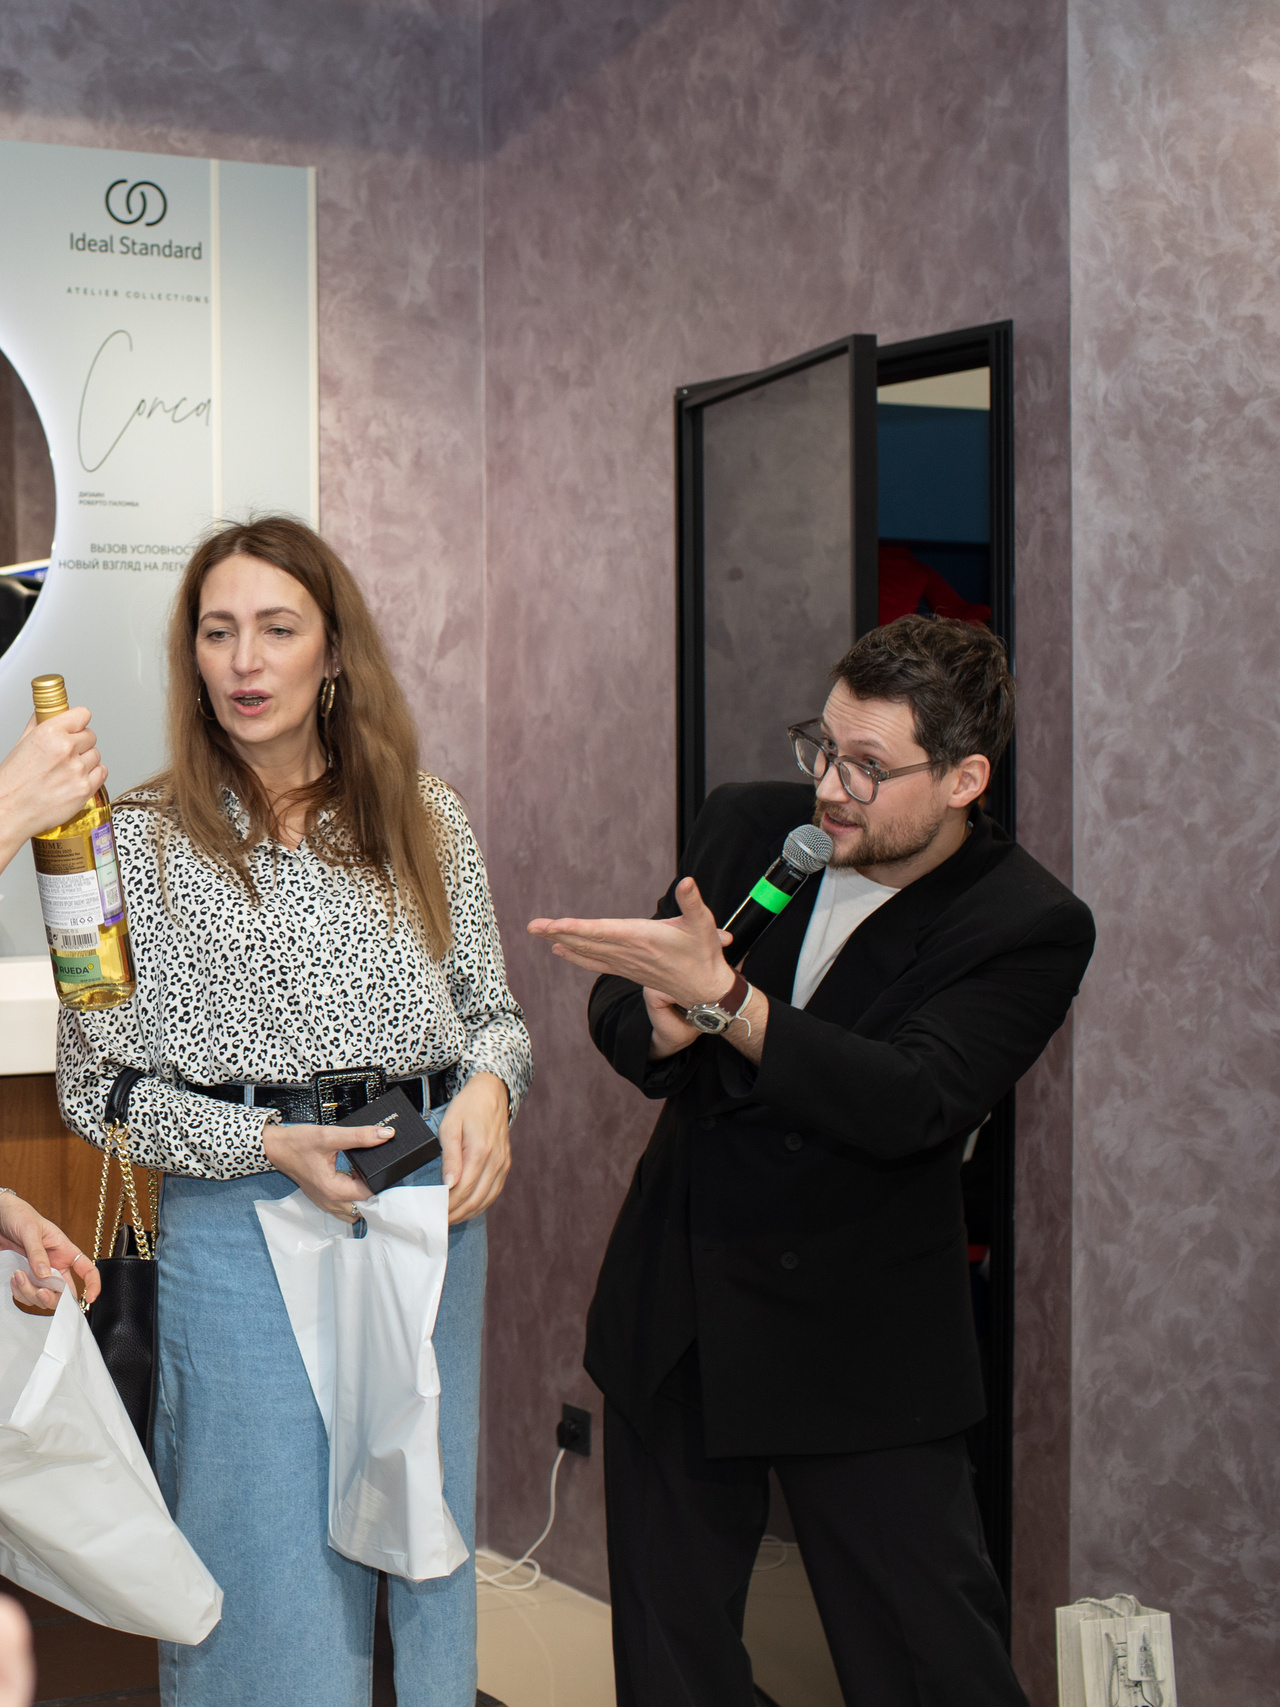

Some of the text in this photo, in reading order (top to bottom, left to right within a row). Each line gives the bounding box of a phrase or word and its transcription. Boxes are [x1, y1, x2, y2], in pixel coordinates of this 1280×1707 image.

[69, 233, 203, 260] Ideal Standard
[66, 287, 210, 304] ATELIER COLLECTIONS
[90, 543, 128, 554] ВЫЗОВ
[58, 558, 100, 570] НОВЫЙ
[102, 560, 142, 572] ВЗГЛЯД
[144, 561, 159, 571] НА
[59, 966, 90, 975] RUEDA
